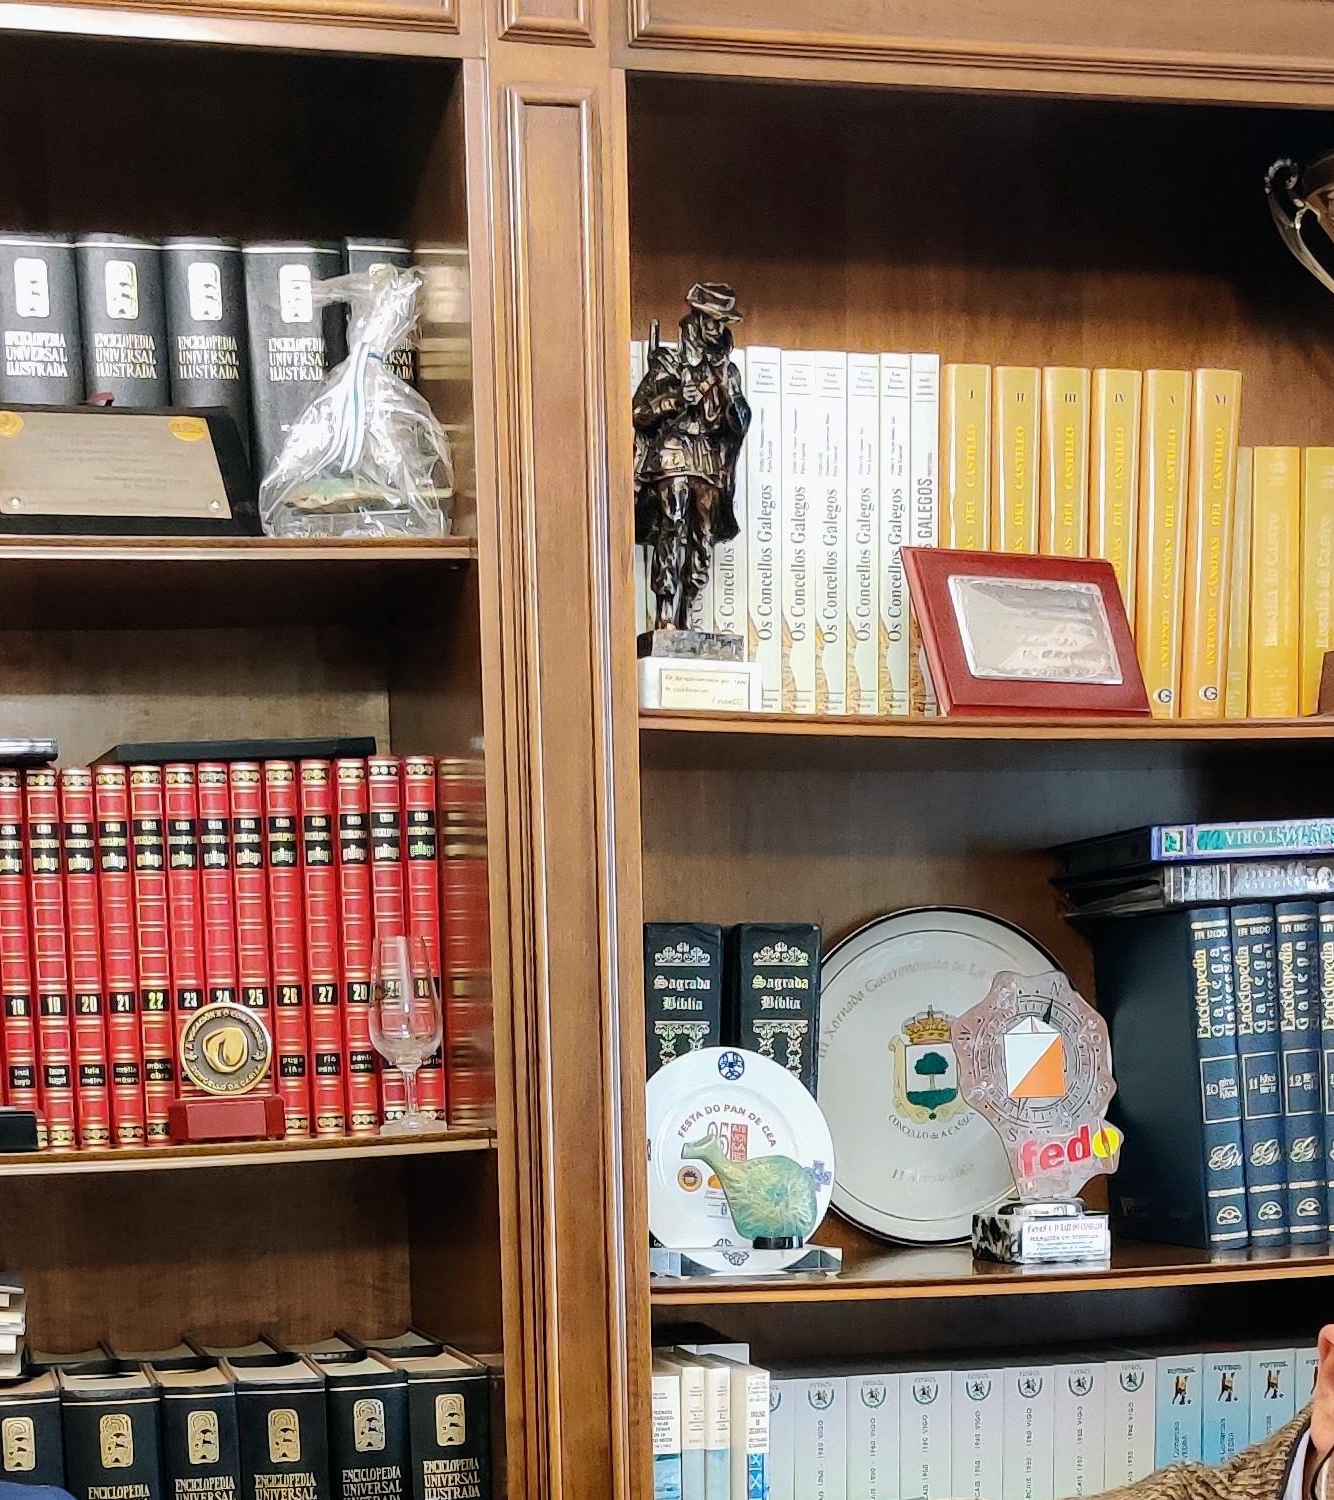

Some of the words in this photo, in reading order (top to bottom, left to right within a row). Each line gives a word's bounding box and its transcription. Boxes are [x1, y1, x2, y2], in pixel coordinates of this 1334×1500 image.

[94, 332, 156, 351] ENCICLOPEDIA
[177, 335, 239, 352] ENCICLOPEDIA
[5, 346, 68, 363] UNIVERSAL
[95, 349, 157, 366] UNIVERSAL
[178, 349, 240, 366] UNIVERSAL
[6, 361, 69, 378] ILUSTRADA
[96, 363, 158, 380] ILUSTRADA
[179, 365, 241, 381] ILUSTRADA
[756, 483, 777, 546] Galegos
[790, 486, 810, 546] Galegos
[855, 487, 876, 547] Galegos
[887, 487, 907, 546] Galegos
[917, 477, 934, 539] GALEGOS
[822, 488, 842, 548] Galegos
[719, 545, 735, 618] Concellos
[757, 546, 774, 618] Concellos
[790, 547, 806, 618] Concellos
[822, 549, 839, 621] Concellos
[855, 548, 871, 619] Concellos
[757, 619, 774, 642] Os
[790, 620, 807, 642] Os
[822, 623, 839, 644] Os
[855, 620, 871, 642] Os
[887, 621, 903, 643] Os
[653, 974, 711, 992] Sagrada
[751, 974, 810, 992] Sagrada
[1235, 944, 1254, 1037] Enciclopedia
[1279, 941, 1299, 1033] Enciclopedia
[116, 994, 130, 1012] 21
[147, 991, 164, 1010] 22
[247, 989, 265, 1007] 25
[317, 986, 334, 1004] 27
[1192, 948, 1212, 1040] Enciclopedia
[80, 994, 98, 1014] 20
[677, 1110, 704, 1139] FESTA
[704, 1103, 721, 1116] DO
[723, 1103, 748, 1118] PAN
[748, 1111, 763, 1127] DE
[761, 1124, 778, 1149] CEA
[341, 1465, 402, 1483] ENCICLOPEDIA
[422, 1457, 480, 1474] ENCICLOPEDIA
[175, 1476, 236, 1493] ENCICLOPEDIA
[254, 1472, 317, 1489] ENCICLOPEDIA
[342, 1479, 403, 1497] UNIVERSAL
[423, 1470, 481, 1488] UNIVERSAL
[88, 1483, 151, 1500] ENCICLOPEDIA
